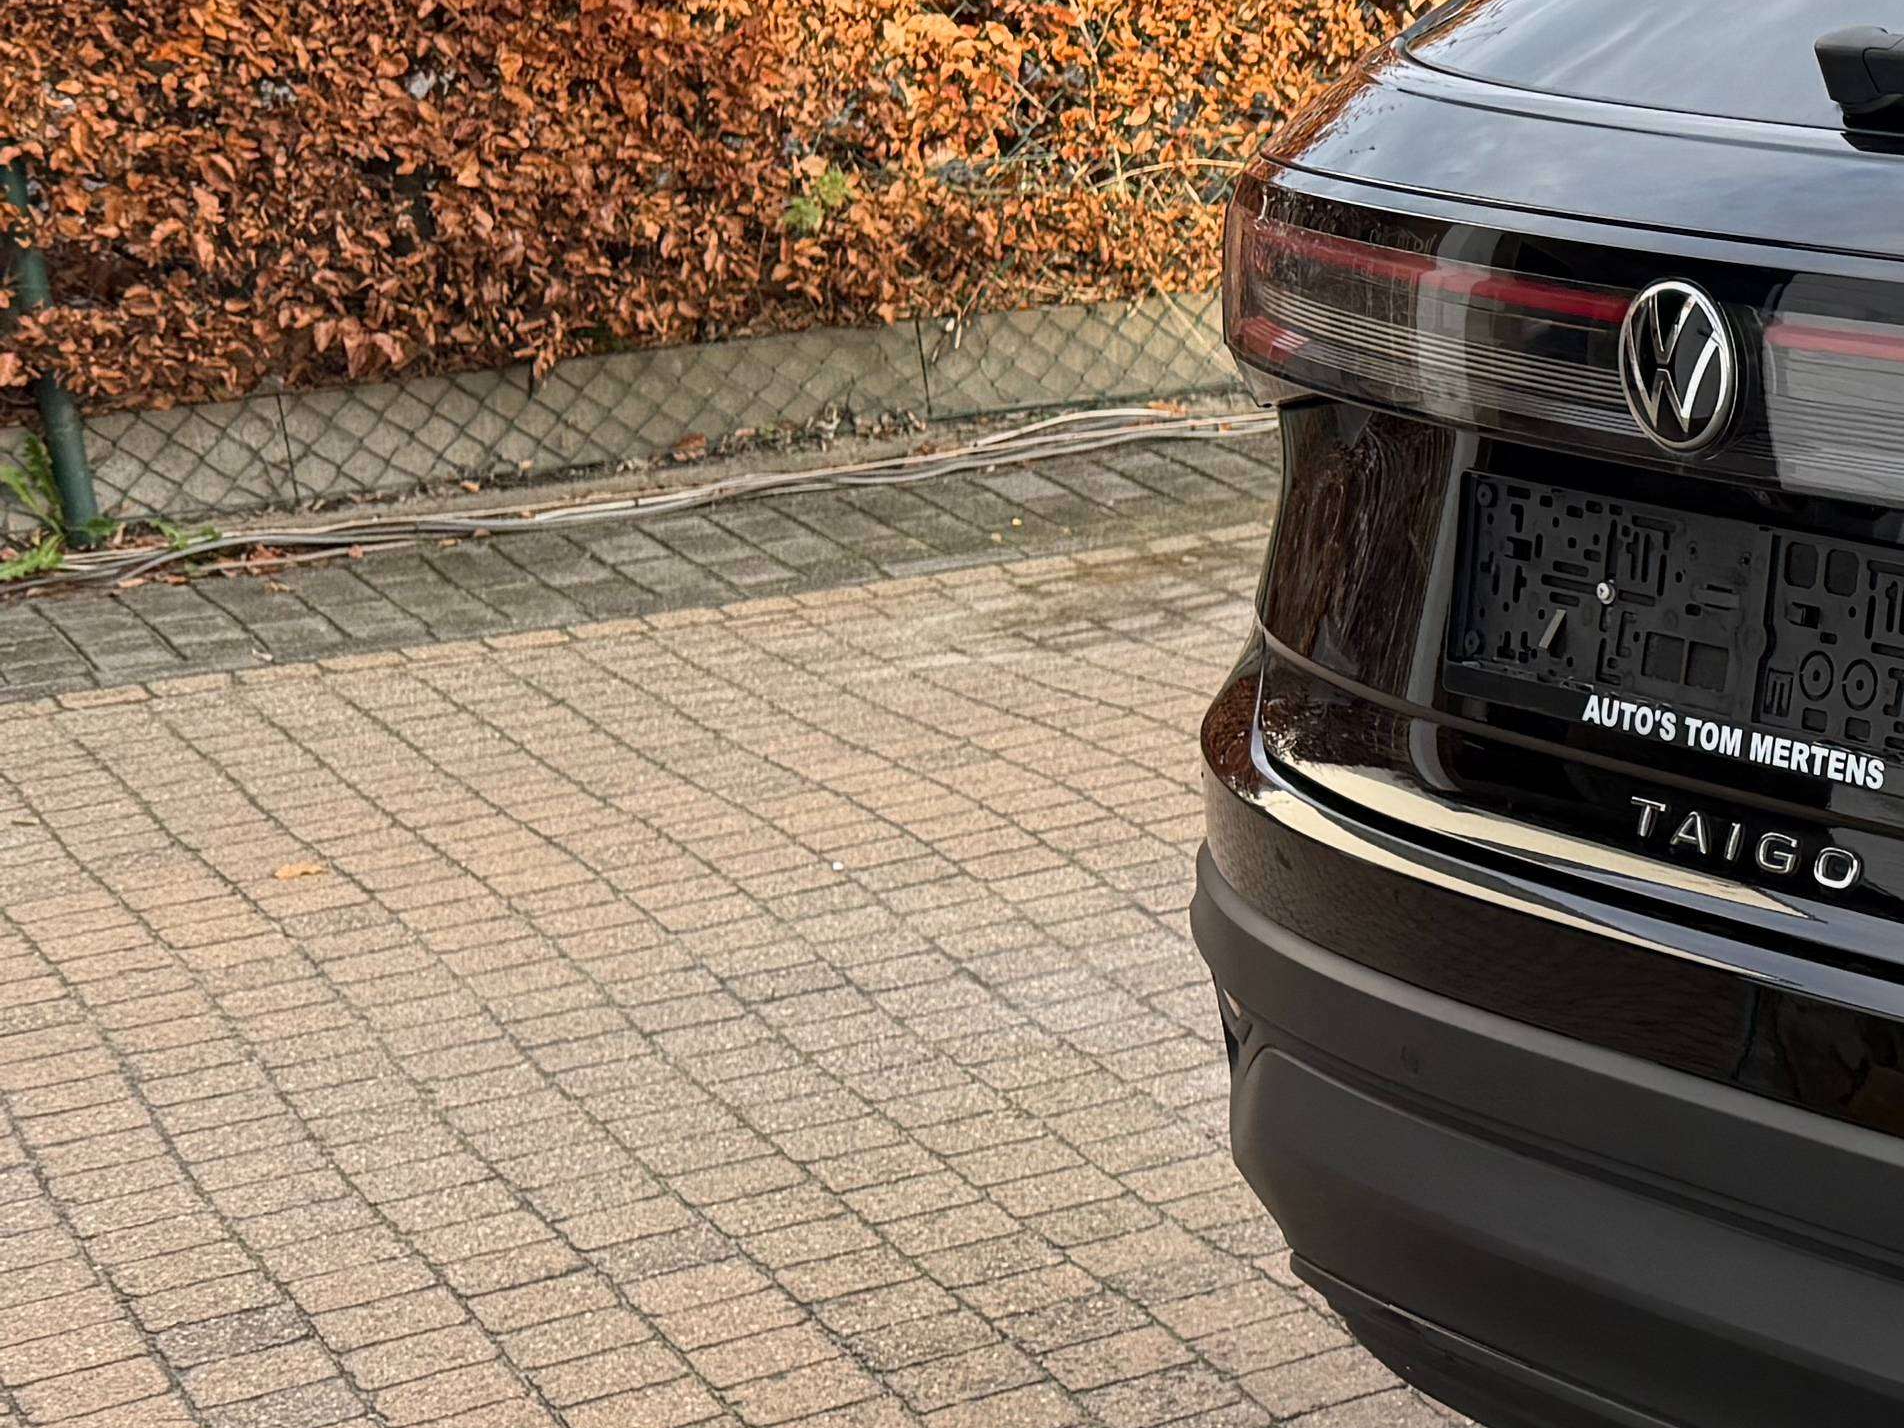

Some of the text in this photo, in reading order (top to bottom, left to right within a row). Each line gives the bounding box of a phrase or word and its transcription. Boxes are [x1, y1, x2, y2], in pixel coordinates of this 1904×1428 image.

[1581, 693, 1886, 791] AUTO'S TOM MERTENS
[1630, 794, 1863, 890] TAIGO
